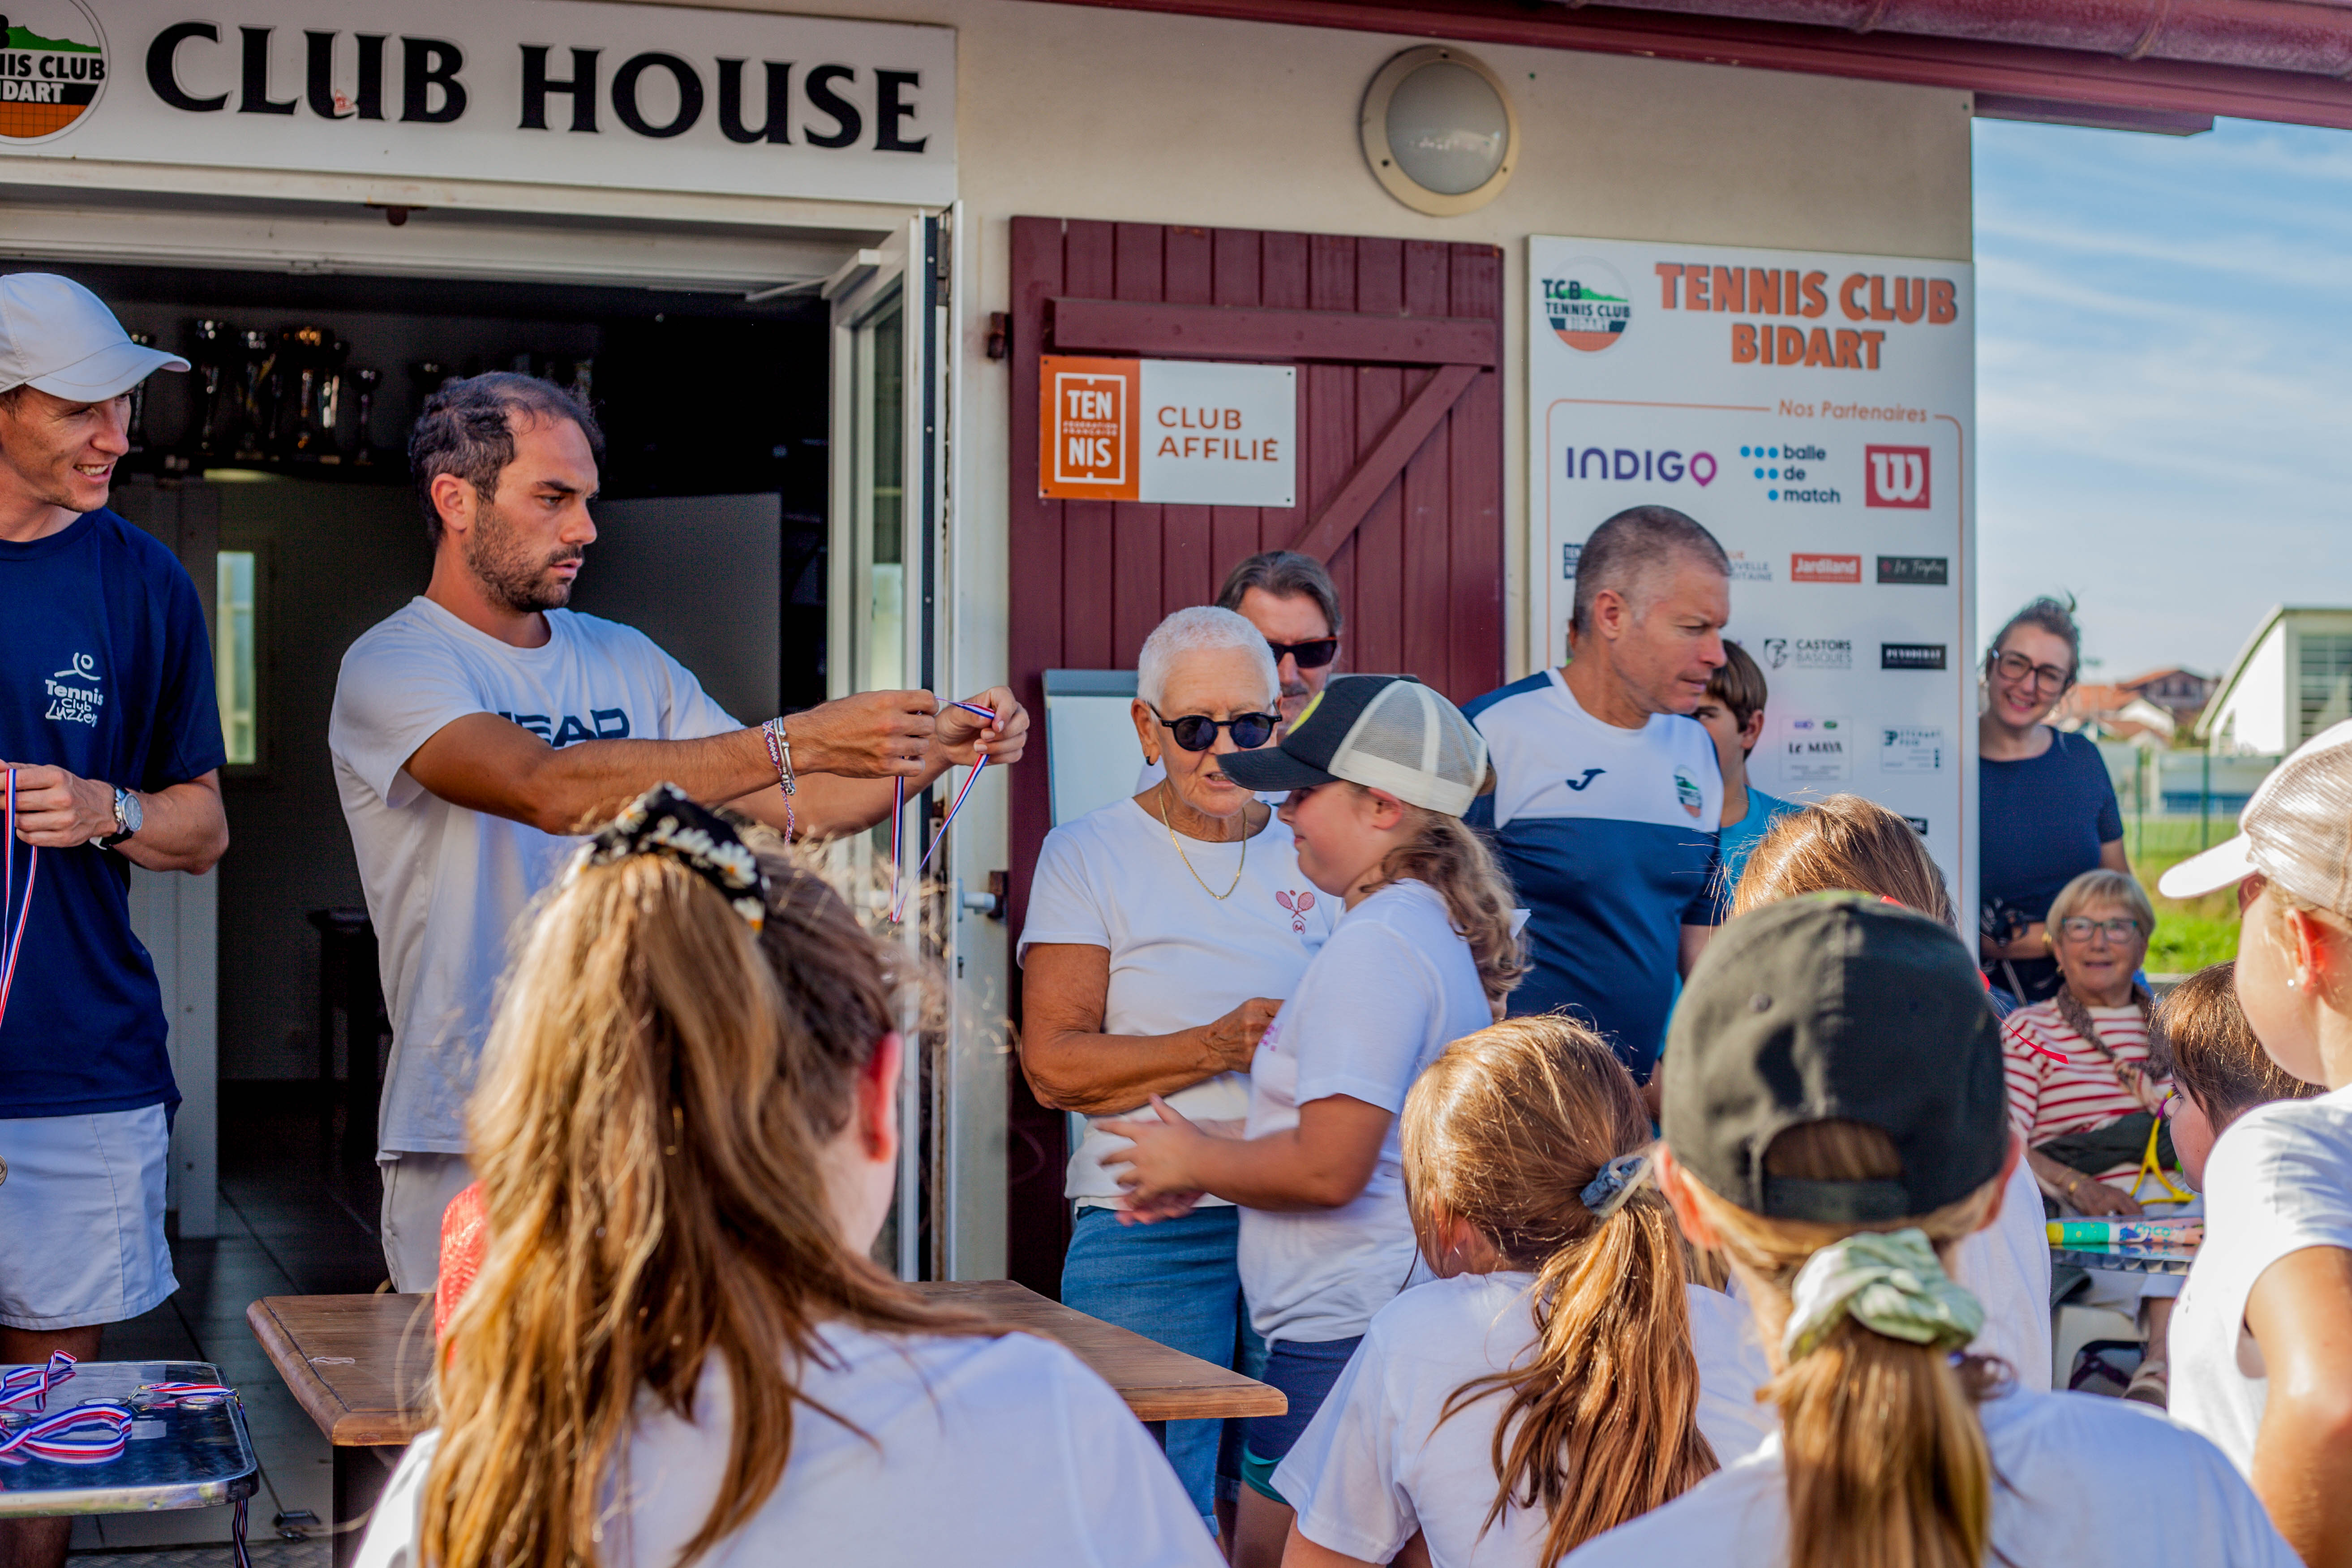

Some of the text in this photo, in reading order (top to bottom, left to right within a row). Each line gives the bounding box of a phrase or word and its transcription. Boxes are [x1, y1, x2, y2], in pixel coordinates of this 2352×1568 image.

[39, 56, 105, 80] CLUB
[0, 81, 64, 103] DART
[146, 21, 930, 153] CLUB HOUSE
[1542, 279, 1581, 300] TCB
[1656, 263, 1957, 325] TENNIS CLUB
[1546, 302, 1630, 318] TENNIS CLUB
[1566, 316, 1611, 332] BIDART
[1732, 324, 1885, 370] BIDART
[1067, 390, 1112, 420] TEN
[1779, 399, 1927, 422] Nos Partenaires
[1158, 407, 1241, 430] CLUB
[1069, 437, 1112, 468] NIS
[1157, 436, 1278, 461] AFFILIÉ
[1783, 443, 1826, 460] balle
[1567, 447, 1717, 487] INDIGO
[1784, 466, 1805, 481] de
[1784, 488, 1841, 503] match
[1795, 558, 1857, 574] Jardiland
[1796, 639, 1852, 651] CASTORS
[45, 679, 103, 706] Tennis
[61, 698, 92, 712] Club
[498, 708, 630, 747] EAD
